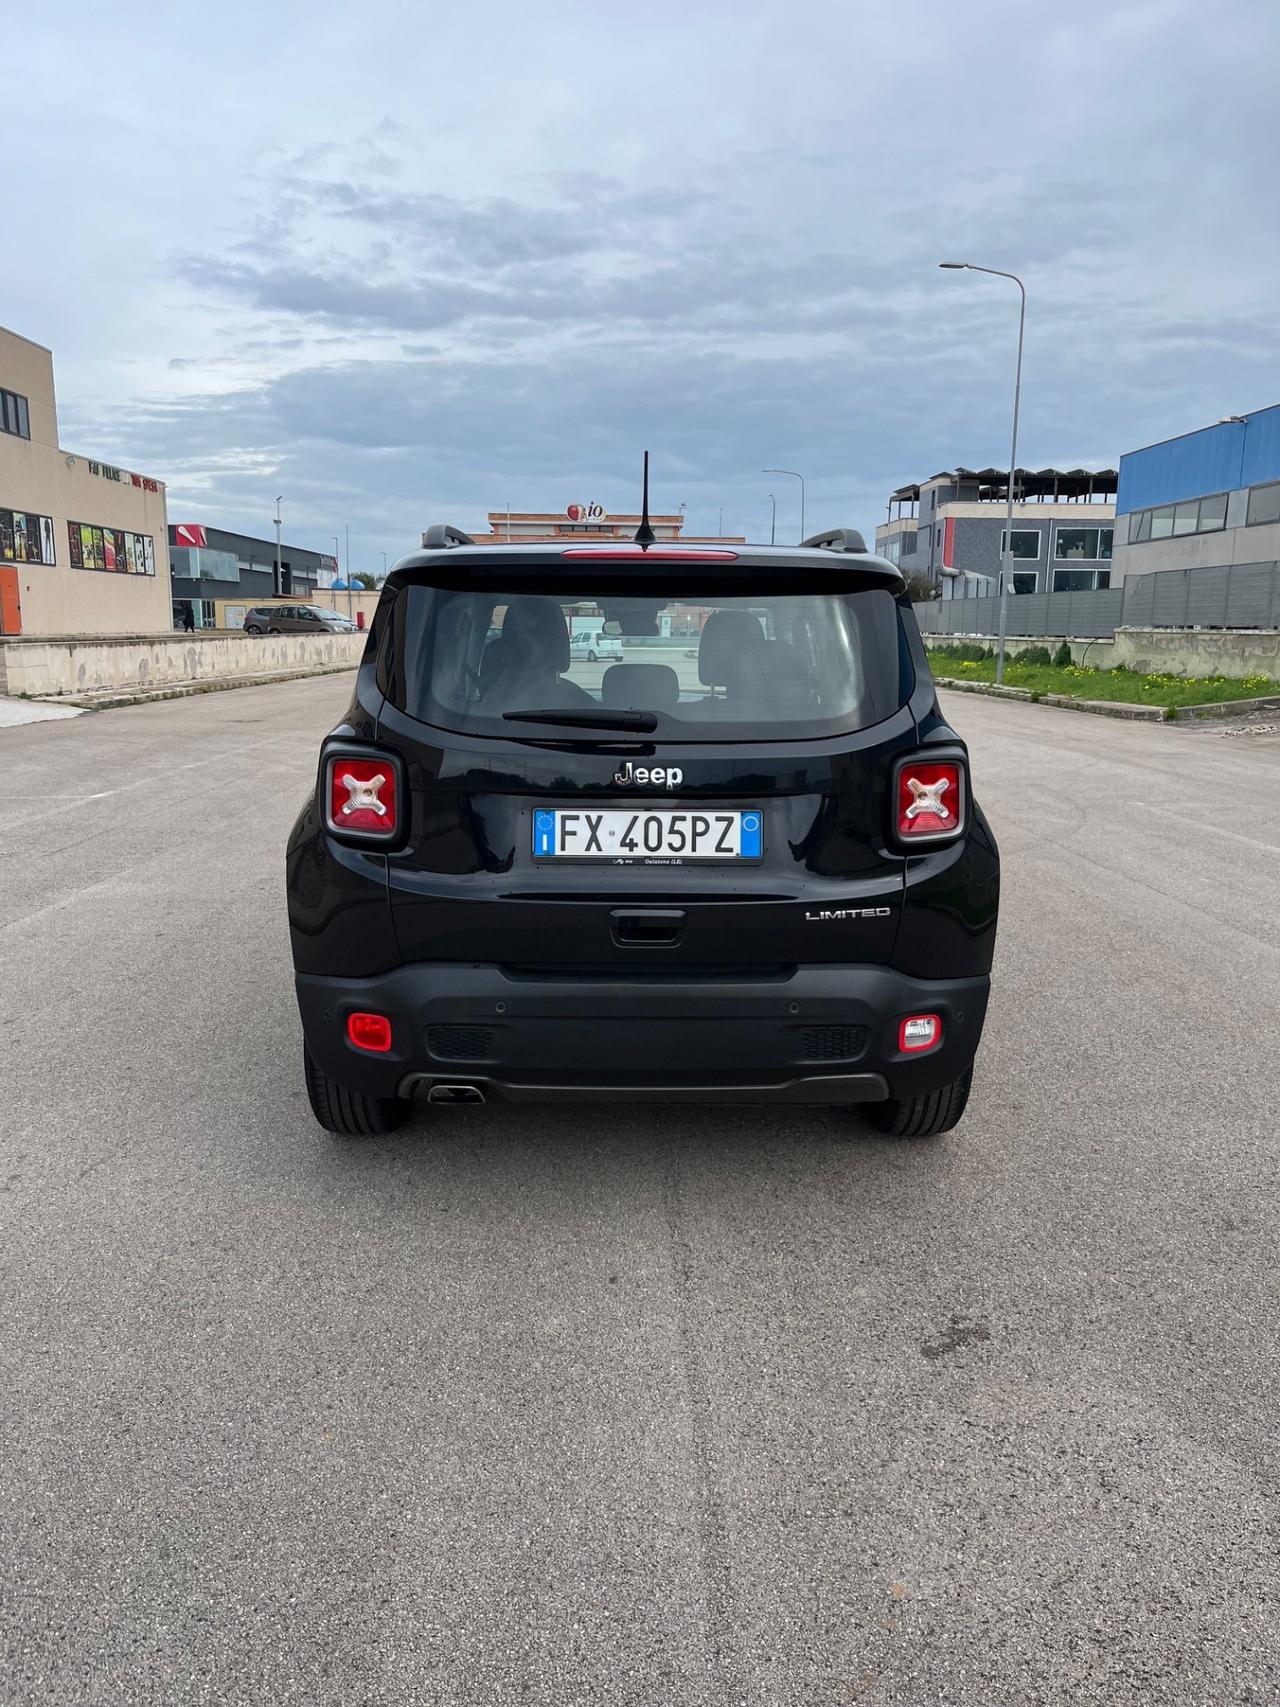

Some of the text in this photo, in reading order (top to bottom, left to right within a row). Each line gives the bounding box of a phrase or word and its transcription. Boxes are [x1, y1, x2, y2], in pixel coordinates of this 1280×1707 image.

[614, 762, 684, 790] Jeep
[560, 814, 603, 852] FX
[619, 815, 735, 853] 405PZ
[805, 907, 891, 920] LIMITED
